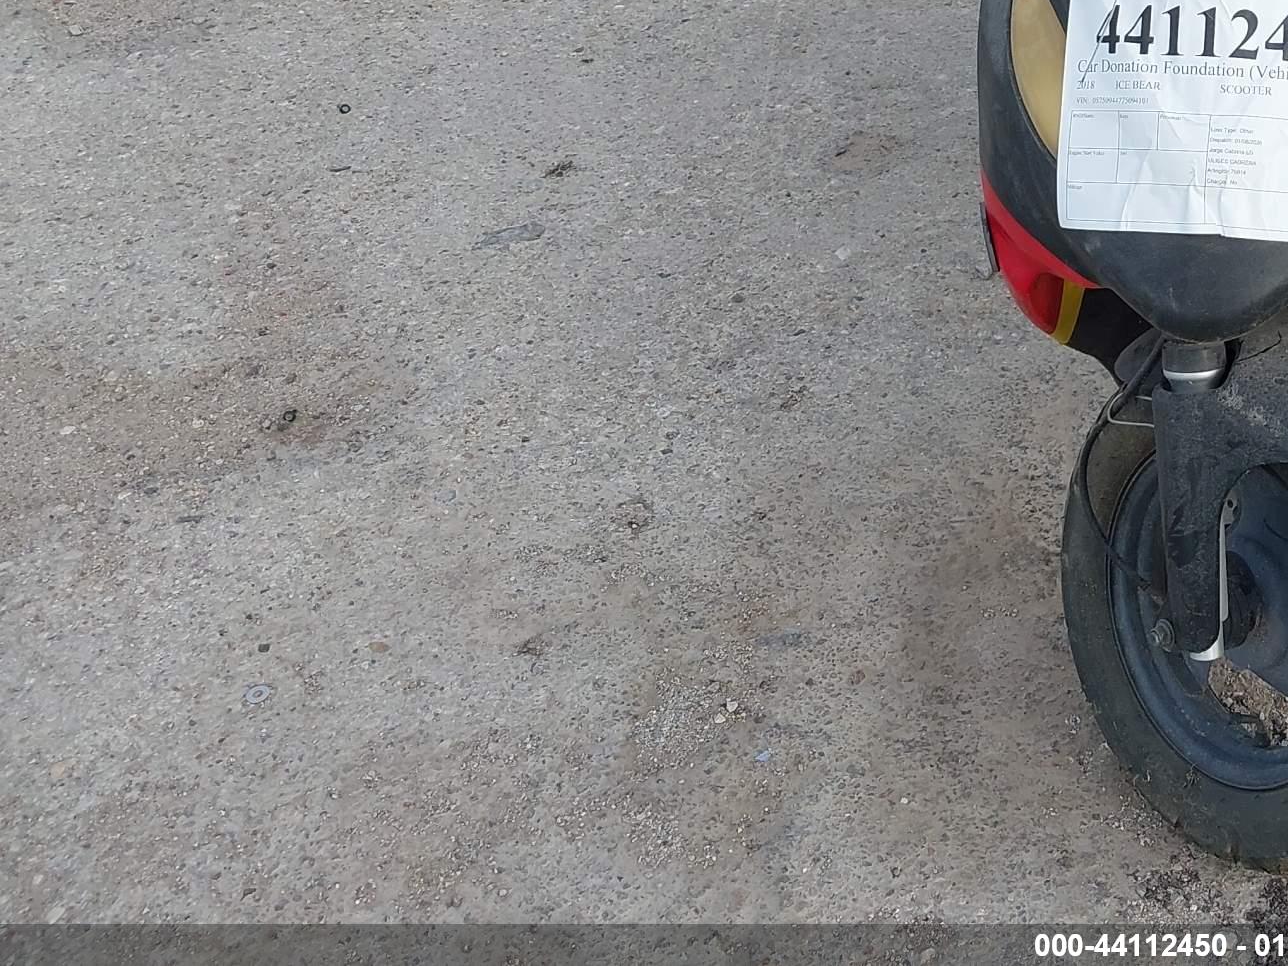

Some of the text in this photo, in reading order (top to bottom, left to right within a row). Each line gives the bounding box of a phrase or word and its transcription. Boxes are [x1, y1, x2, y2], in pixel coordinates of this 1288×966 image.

[1077, 59, 1099, 73] Car
[1101, 58, 1159, 74] Donation
[1163, 60, 1245, 78] Foundation
[1132, 80, 1161, 91] BEAR
[1220, 84, 1272, 96] SCOOTER
